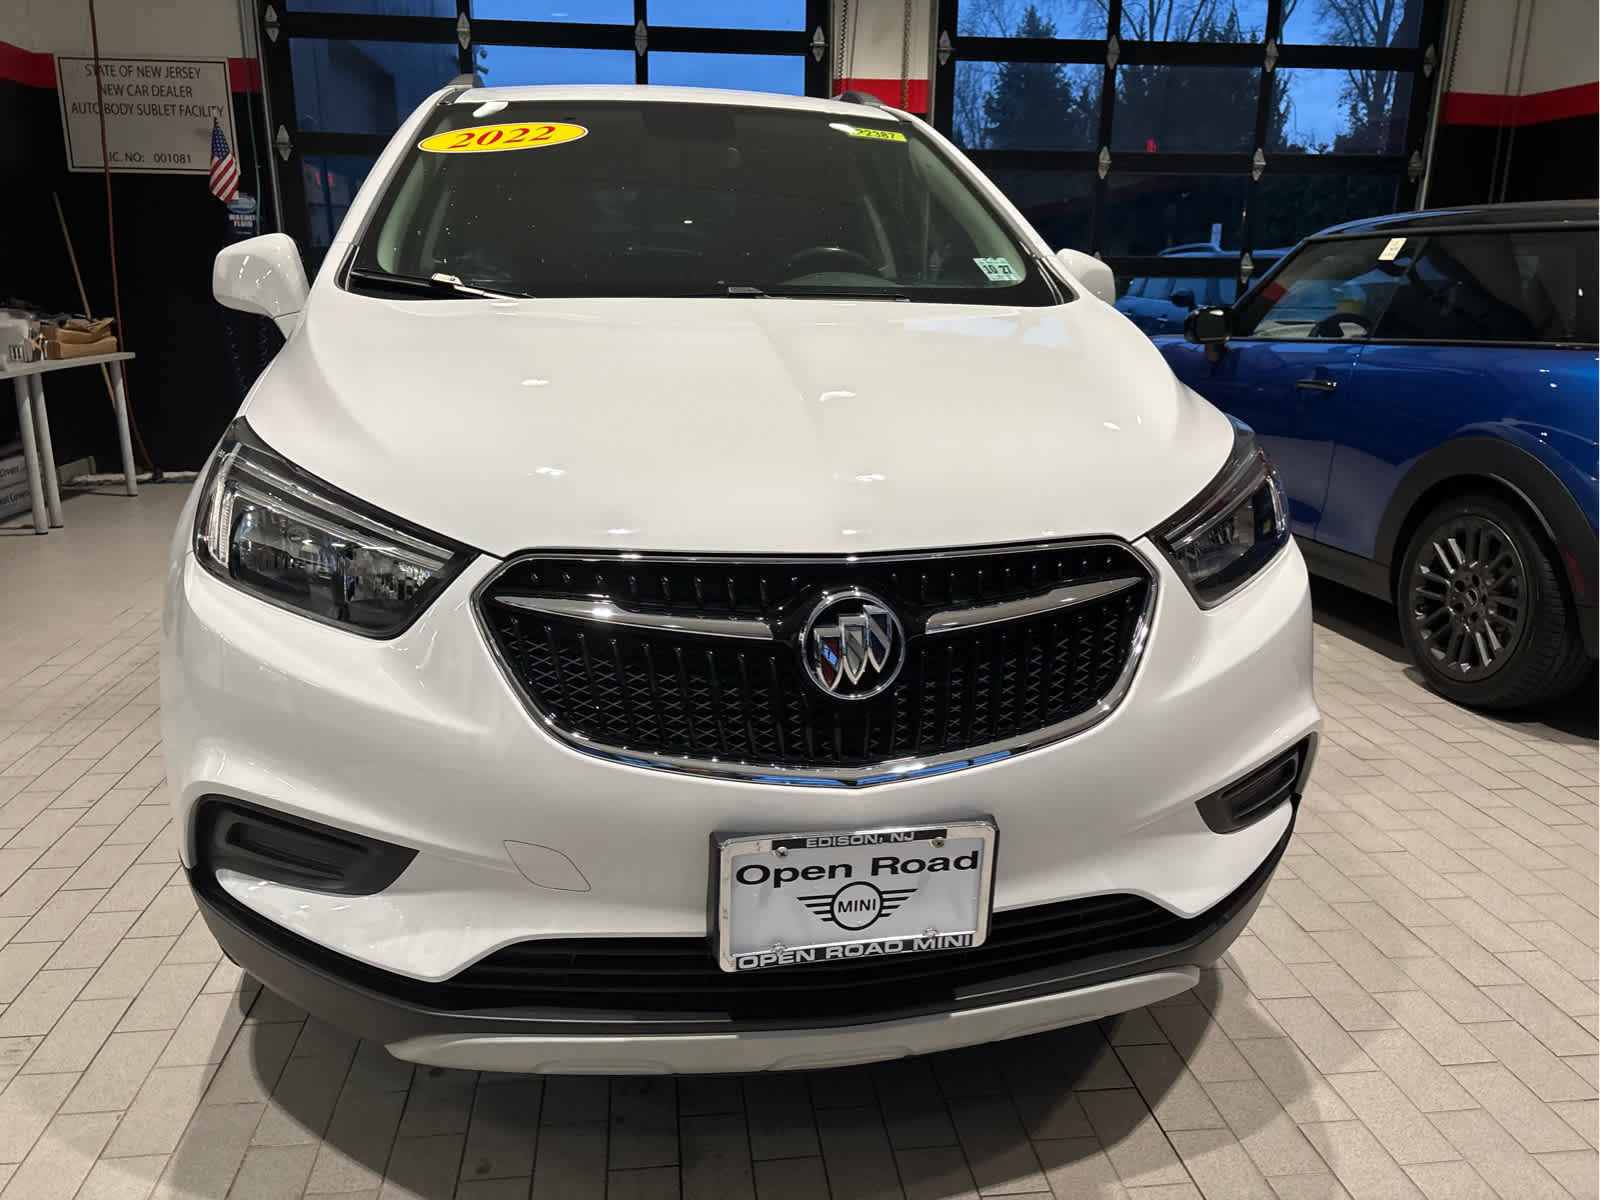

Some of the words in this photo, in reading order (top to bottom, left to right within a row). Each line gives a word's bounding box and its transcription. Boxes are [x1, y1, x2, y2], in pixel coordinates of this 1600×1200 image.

[84, 63, 117, 77] STATE
[119, 64, 134, 78] OF
[136, 65, 162, 78] NEW
[164, 66, 201, 80] JERSEY
[99, 83, 125, 97] NEW
[126, 84, 149, 97] CAR
[151, 84, 193, 98] DEALER
[71, 101, 102, 115] AUTO
[103, 102, 134, 116] BODY
[136, 103, 177, 117] SUBLET
[178, 104, 224, 118] FACILITY
[448, 126, 556, 149] 2022
[105, 151, 123, 163] IC.
[124, 152, 145, 163] NO:
[153, 152, 192, 164] 001081
[806, 833, 884, 848] EDISON,
[890, 831, 915, 842] NJ
[735, 863, 853, 889] Open
[870, 850, 979, 877] Road
[837, 898, 877, 913] MINI
[738, 949, 816, 969] OPEN
[825, 939, 904, 960] ROAD
[913, 934, 973, 951] MINI
